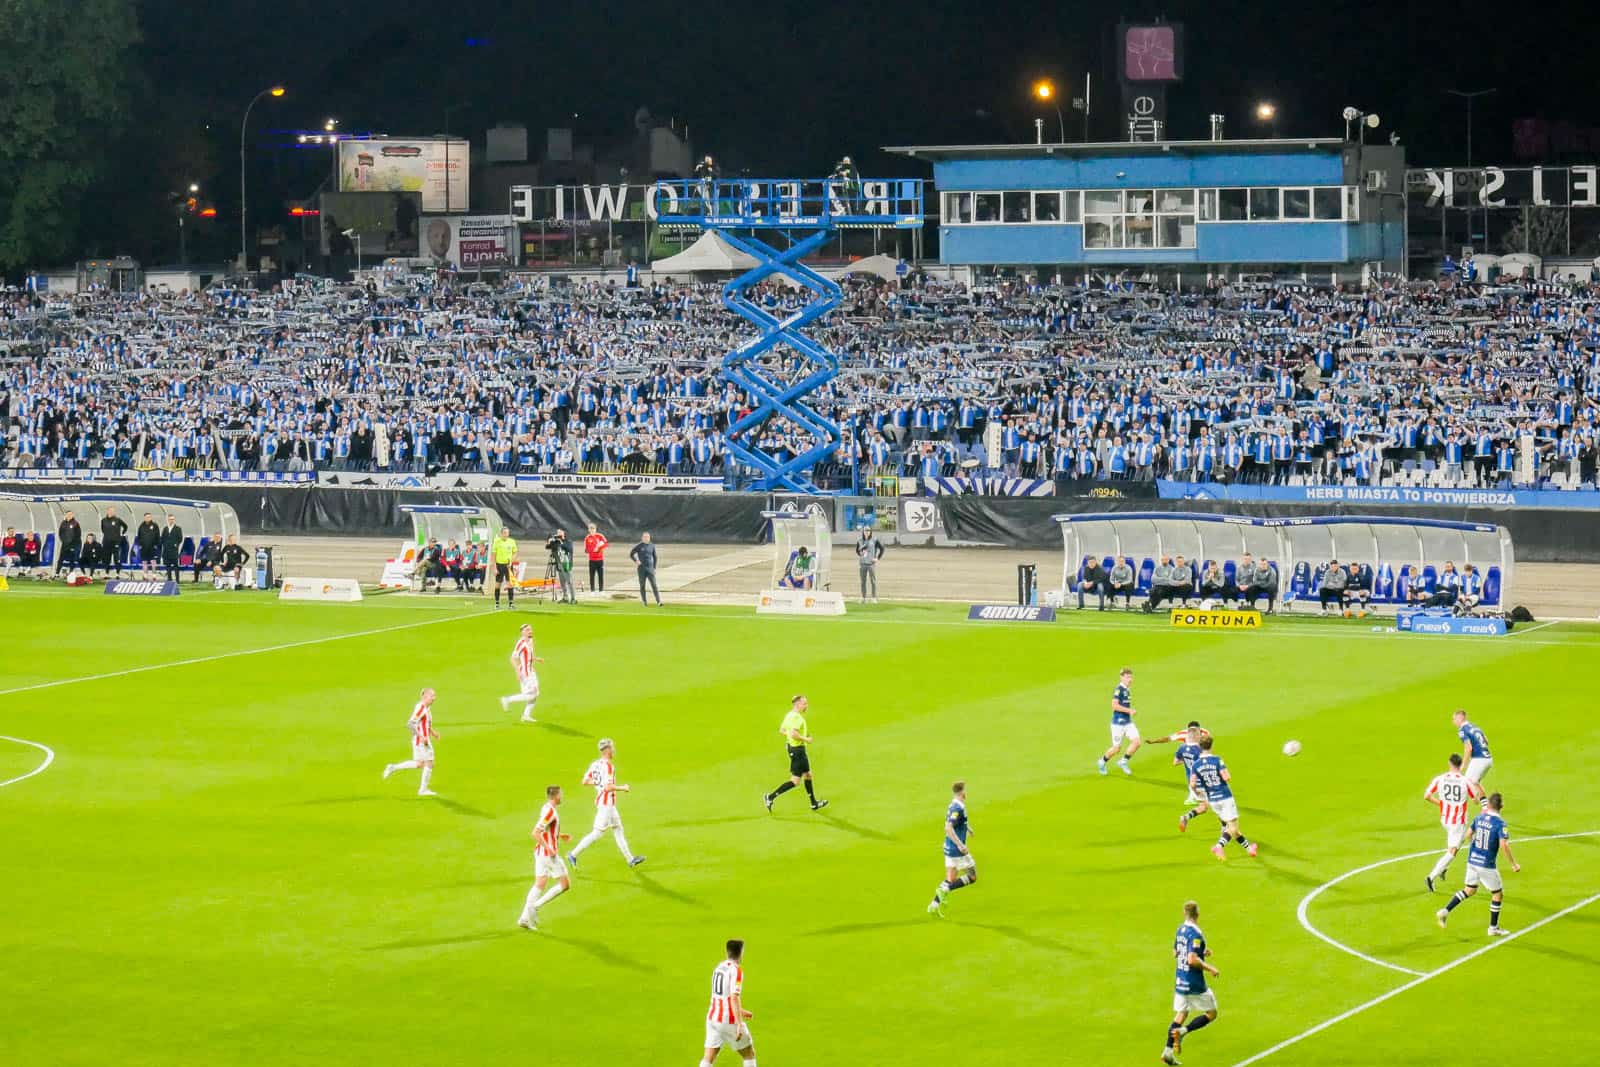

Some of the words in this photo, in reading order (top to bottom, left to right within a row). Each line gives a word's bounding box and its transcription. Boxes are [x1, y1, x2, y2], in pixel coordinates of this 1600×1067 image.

[1306, 488, 1344, 499] HERB
[1347, 489, 1400, 501] MIASTA
[1402, 489, 1421, 501] TO
[1423, 491, 1516, 505] POTWIERDZA
[1263, 519, 1286, 528] AWAY
[113, 581, 165, 595] 4MOVE
[979, 605, 1041, 620] 4MOVE
[1174, 613, 1257, 627] FORTUNA
[1443, 784, 1462, 803] 29
